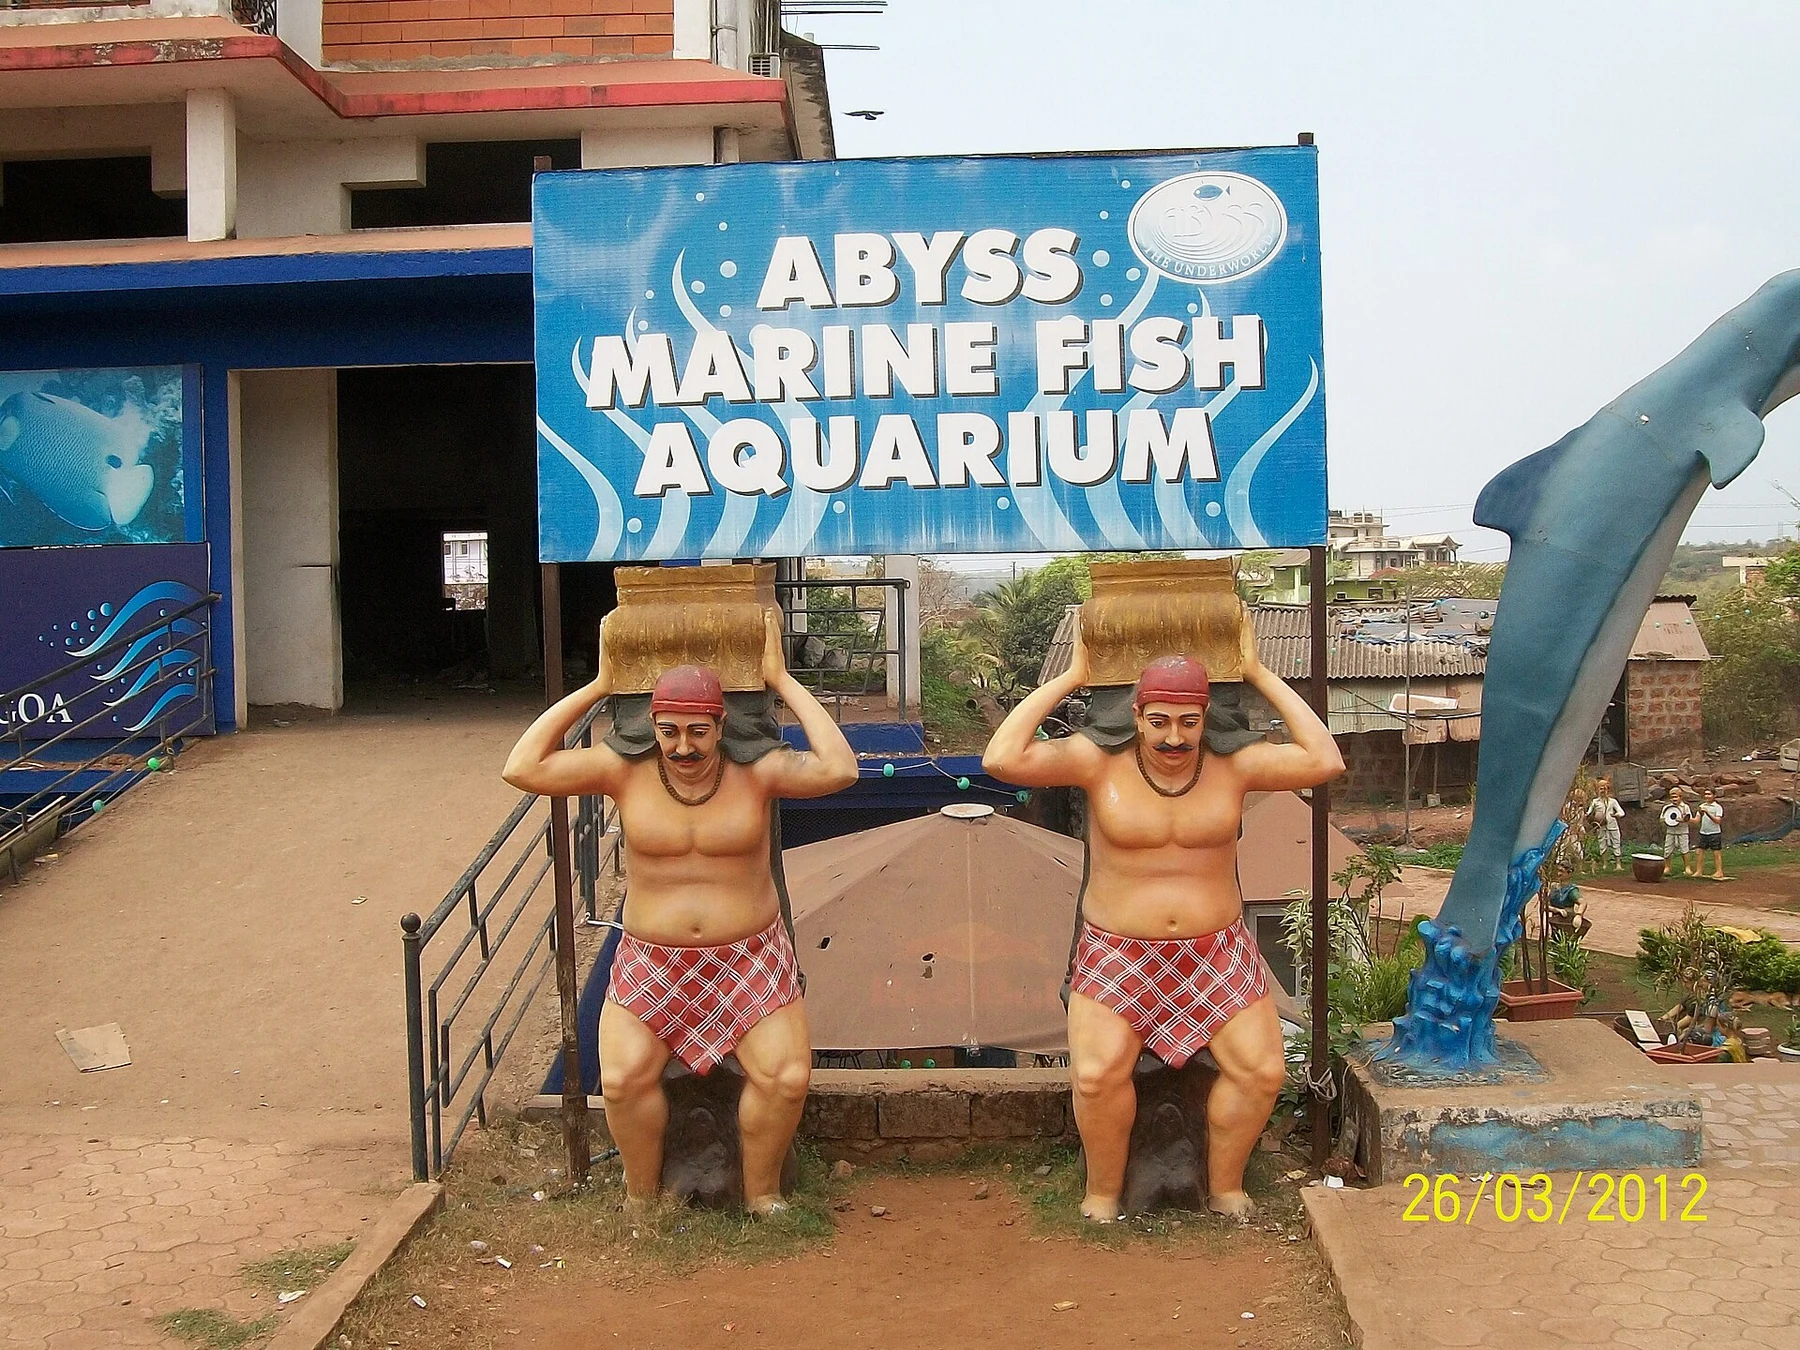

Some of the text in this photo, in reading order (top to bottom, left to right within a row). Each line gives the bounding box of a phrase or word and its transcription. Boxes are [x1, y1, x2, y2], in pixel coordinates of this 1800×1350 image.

[757, 228, 1083, 309] ABYSS
[1145, 234, 1274, 277] THE UNDERWORLD
[586, 315, 1266, 409] MARINE FISH
[634, 407, 1219, 498] AQUARIUM
